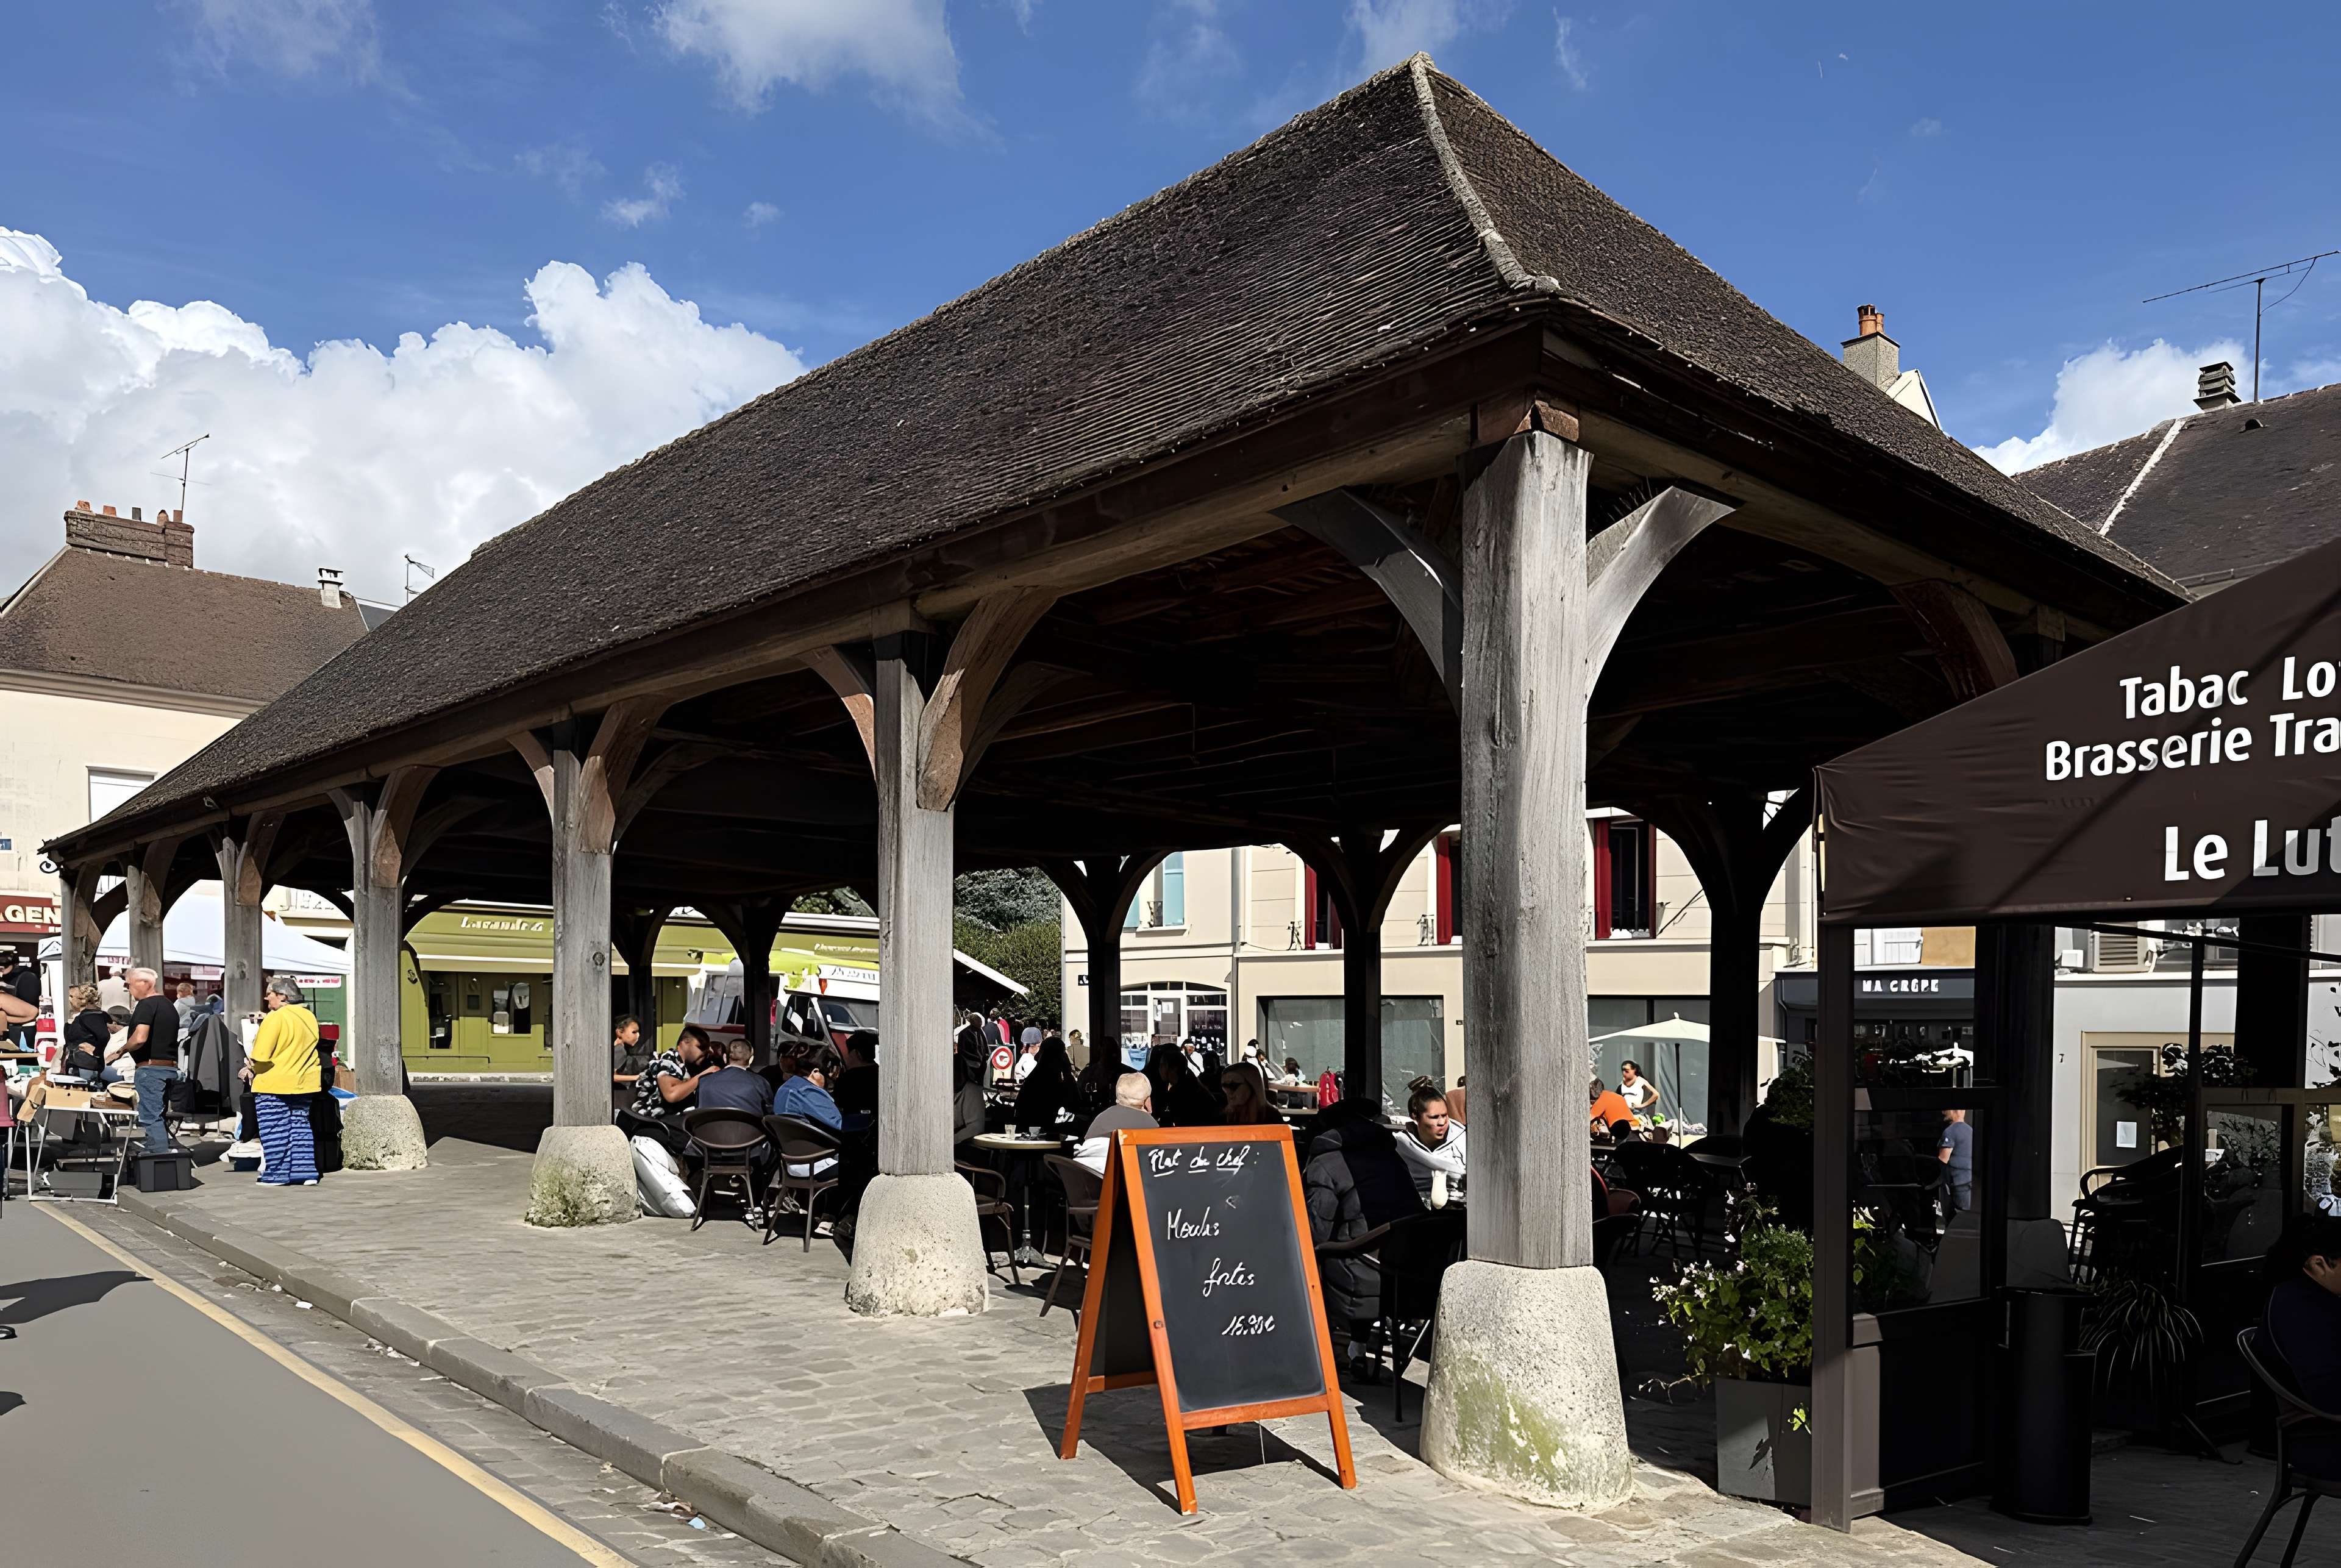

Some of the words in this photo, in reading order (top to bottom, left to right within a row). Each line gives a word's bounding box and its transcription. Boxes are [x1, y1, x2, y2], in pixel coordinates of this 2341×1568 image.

[2119, 665, 2249, 719] Tabac
[2282, 656, 2341, 701] Lo
[2046, 717, 2252, 781] Brasserie
[2269, 713, 2341, 757] Tra
[2164, 826, 2228, 882] Le
